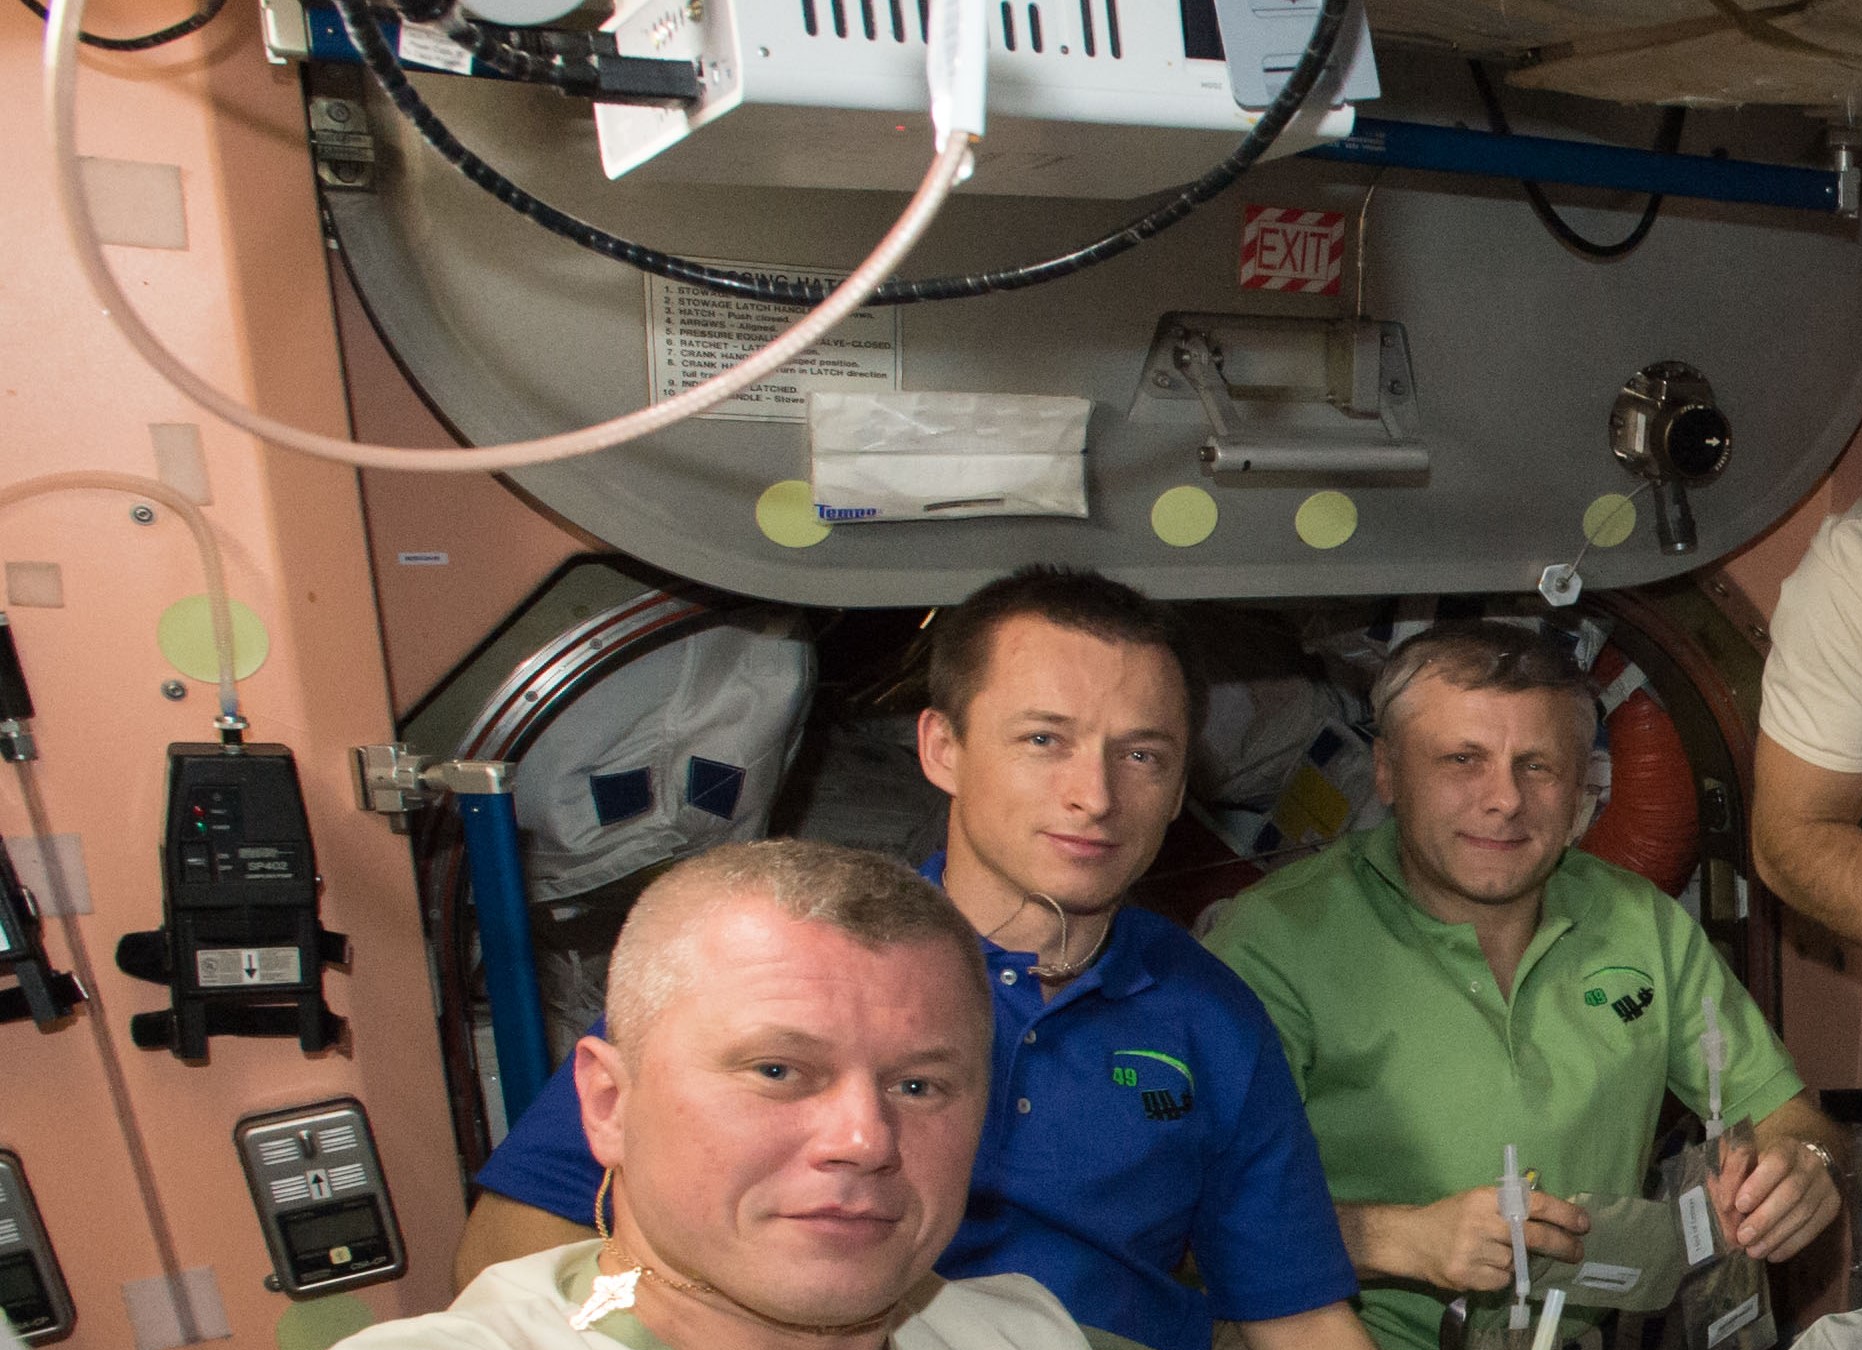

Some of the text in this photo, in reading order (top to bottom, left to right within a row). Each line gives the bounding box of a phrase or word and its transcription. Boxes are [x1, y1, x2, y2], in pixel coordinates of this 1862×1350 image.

[1258, 226, 1330, 274] EXIT
[679, 298, 733, 310] STOWAGE
[736, 302, 771, 313] LATCH
[774, 305, 813, 315] HANDL
[679, 308, 716, 318] HATCH
[728, 312, 753, 321] Push
[680, 318, 727, 329] ARROWS
[680, 328, 734, 340] PRESSURE
[680, 339, 729, 350] RATCHET
[681, 348, 717, 359] CRANK
[682, 359, 717, 369] CRANK
[811, 367, 845, 377] LATCH
[846, 370, 888, 379] direction
[814, 503, 877, 521] Tempo
[1584, 987, 1608, 1007] 49
[1112, 1067, 1138, 1087] 49
